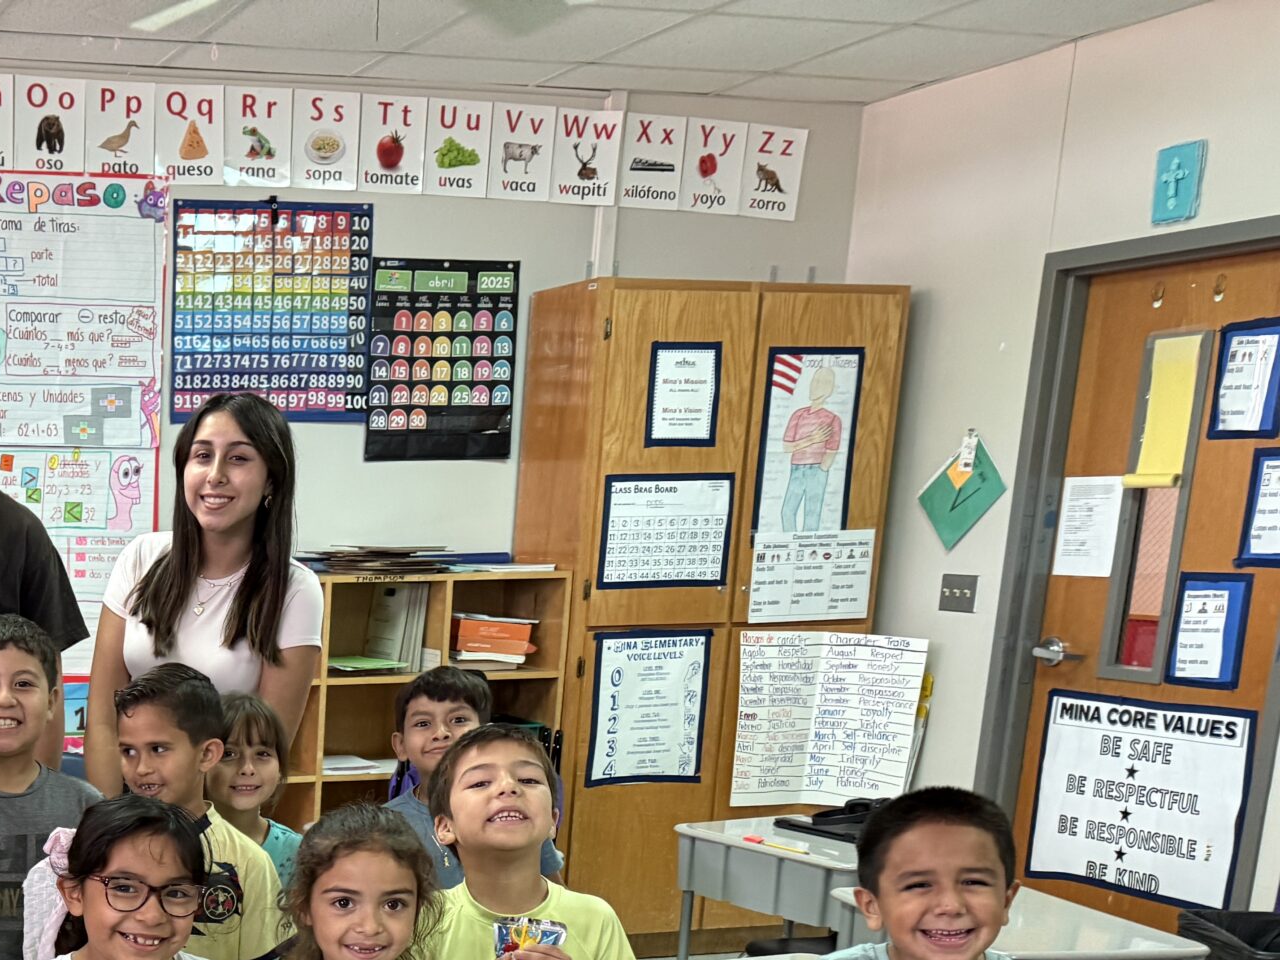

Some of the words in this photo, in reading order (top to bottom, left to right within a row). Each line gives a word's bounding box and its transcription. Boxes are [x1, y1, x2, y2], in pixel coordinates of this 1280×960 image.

[35, 157, 64, 171] oso
[101, 158, 140, 175] pato
[166, 161, 214, 180] queso
[238, 163, 276, 179] rana
[305, 167, 342, 185] sopa
[364, 170, 420, 188] tomate
[438, 174, 473, 190] uvas
[502, 177, 537, 193] vaca
[558, 181, 607, 199] wapití
[623, 184, 676, 202] xilófono
[691, 190, 726, 209] yoyo
[749, 196, 787, 213] zorro
[34, 216, 47, 232] de
[352, 216, 370, 231] 10
[351, 236, 368, 251] 20
[31, 248, 54, 263] parte
[428, 275, 454, 289] abril
[481, 277, 511, 289] 2025
[8, 309, 62, 326] Comparar
[98, 310, 126, 325] resta
[42, 390, 84, 404] Unidades
[829, 634, 879, 646] Character
[826, 646, 856, 658] August
[1060, 703, 1102, 724] MINA
[1107, 708, 1157, 731] CORE
[1163, 714, 1238, 740] VALUES
[1100, 735, 1122, 757] BE
[1128, 739, 1173, 765] SAFE
[1066, 774, 1087, 795] BE
[1093, 779, 1200, 816] RESPECTFUL
[1058, 815, 1078, 836] BE
[1085, 820, 1197, 861] RESPONSIBLE
[1086, 861, 1108, 881] BE
[1115, 868, 1160, 894] KIND
